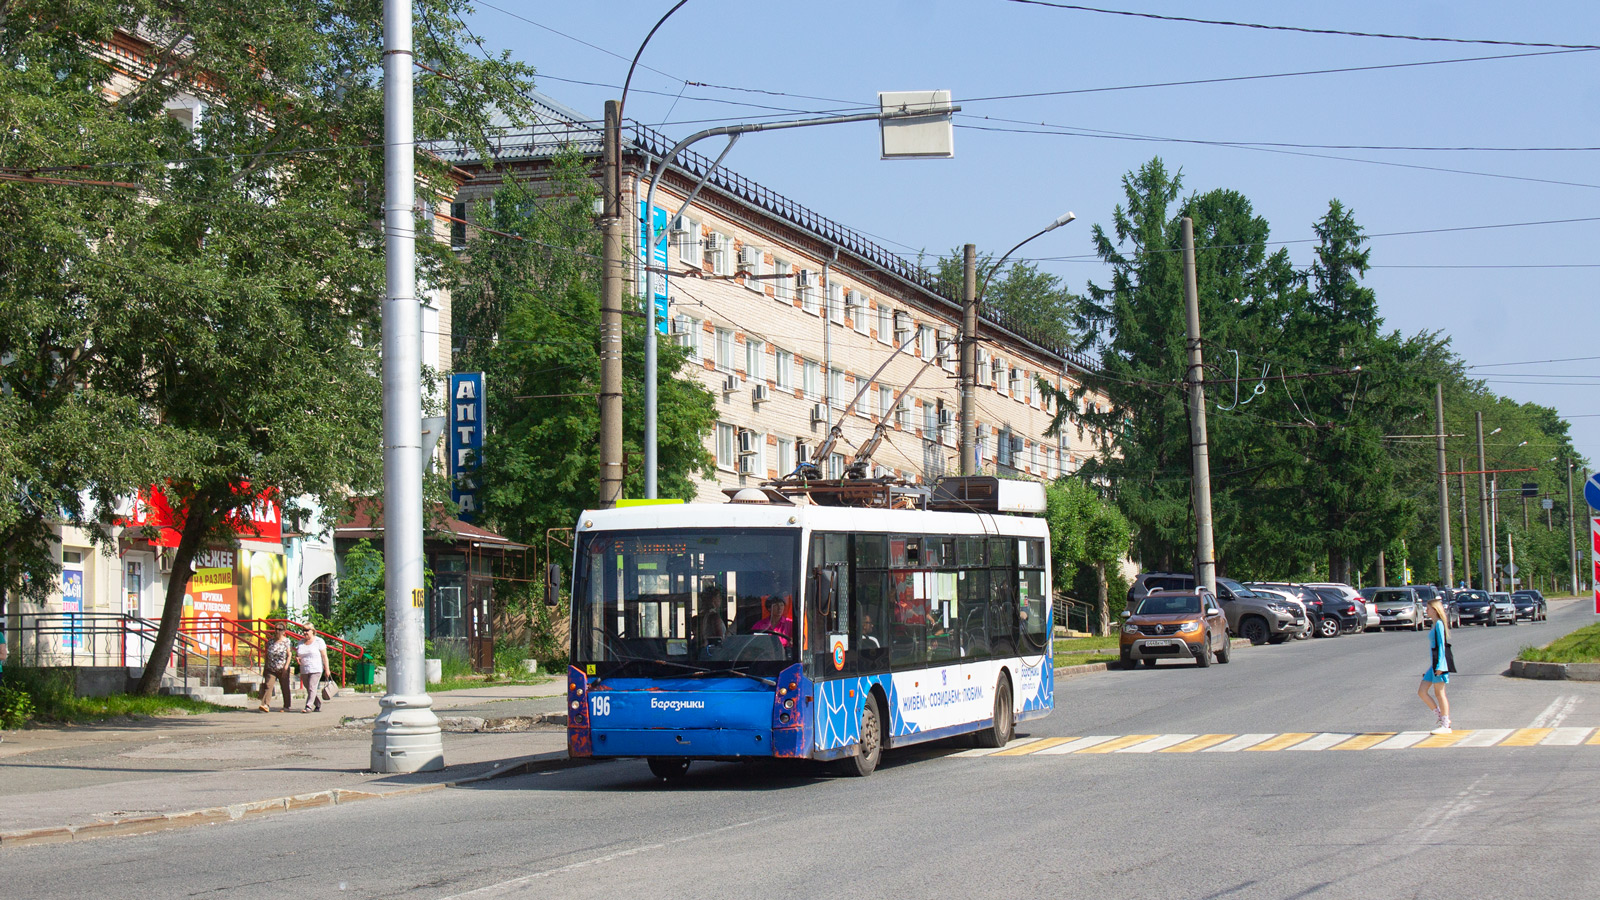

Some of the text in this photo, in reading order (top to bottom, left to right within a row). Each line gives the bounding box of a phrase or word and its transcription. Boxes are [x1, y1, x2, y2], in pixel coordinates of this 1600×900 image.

[193, 572, 232, 587] НА РАЗЛИВ
[201, 591, 224, 603] КРУЖКА
[193, 601, 231, 613] ЖИГУЛЕВСКОЕ
[591, 696, 611, 716] 196
[650, 697, 705, 712] Березники
